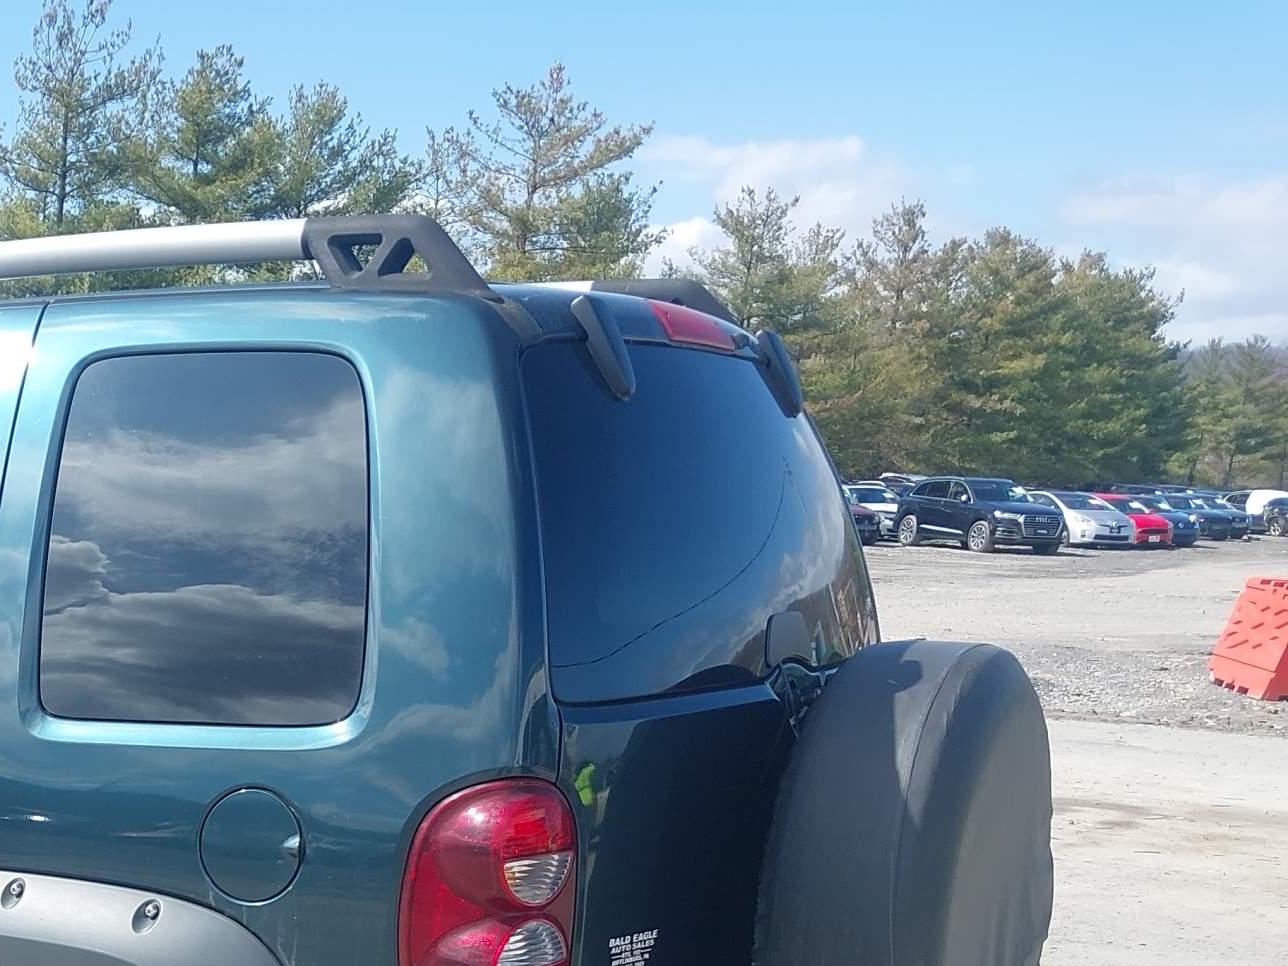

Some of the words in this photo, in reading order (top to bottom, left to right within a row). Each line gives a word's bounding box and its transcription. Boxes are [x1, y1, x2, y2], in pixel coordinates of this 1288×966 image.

[609, 936, 631, 947] BALD
[632, 929, 659, 943] EAGLE
[610, 944, 632, 955] AUTO
[632, 939, 655, 950] SALES
